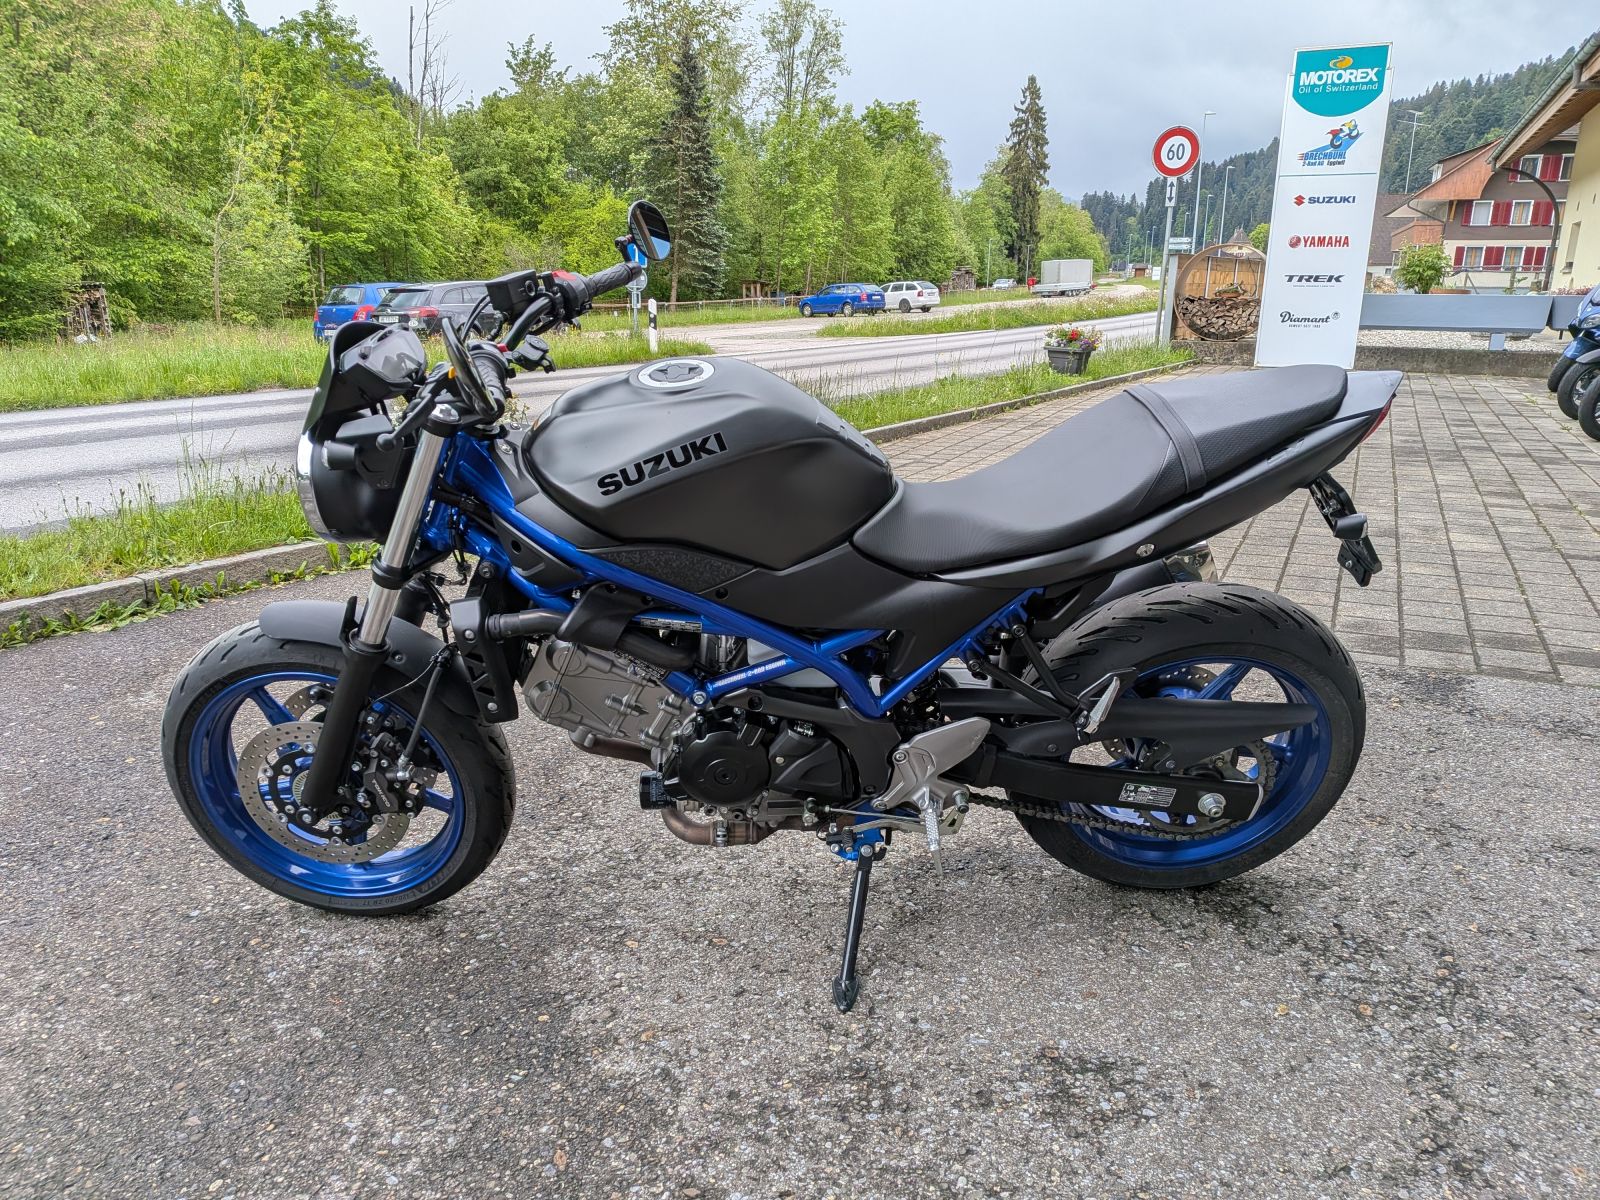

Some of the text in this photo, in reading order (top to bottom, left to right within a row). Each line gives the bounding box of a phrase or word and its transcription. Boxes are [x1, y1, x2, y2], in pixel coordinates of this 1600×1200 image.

[1300, 67, 1378, 86] MOTOREX
[1298, 83, 1378, 94] Oil of Switzerland
[1166, 142, 1186, 161] 60
[1307, 195, 1356, 204] SUZUKI
[1302, 235, 1350, 248] YAMAHA
[1284, 274, 1345, 283] TREK
[1279, 310, 1331, 323] Diamant
[597, 432, 728, 497] SUZUKI
[371, 778, 390, 807] TOKICO
